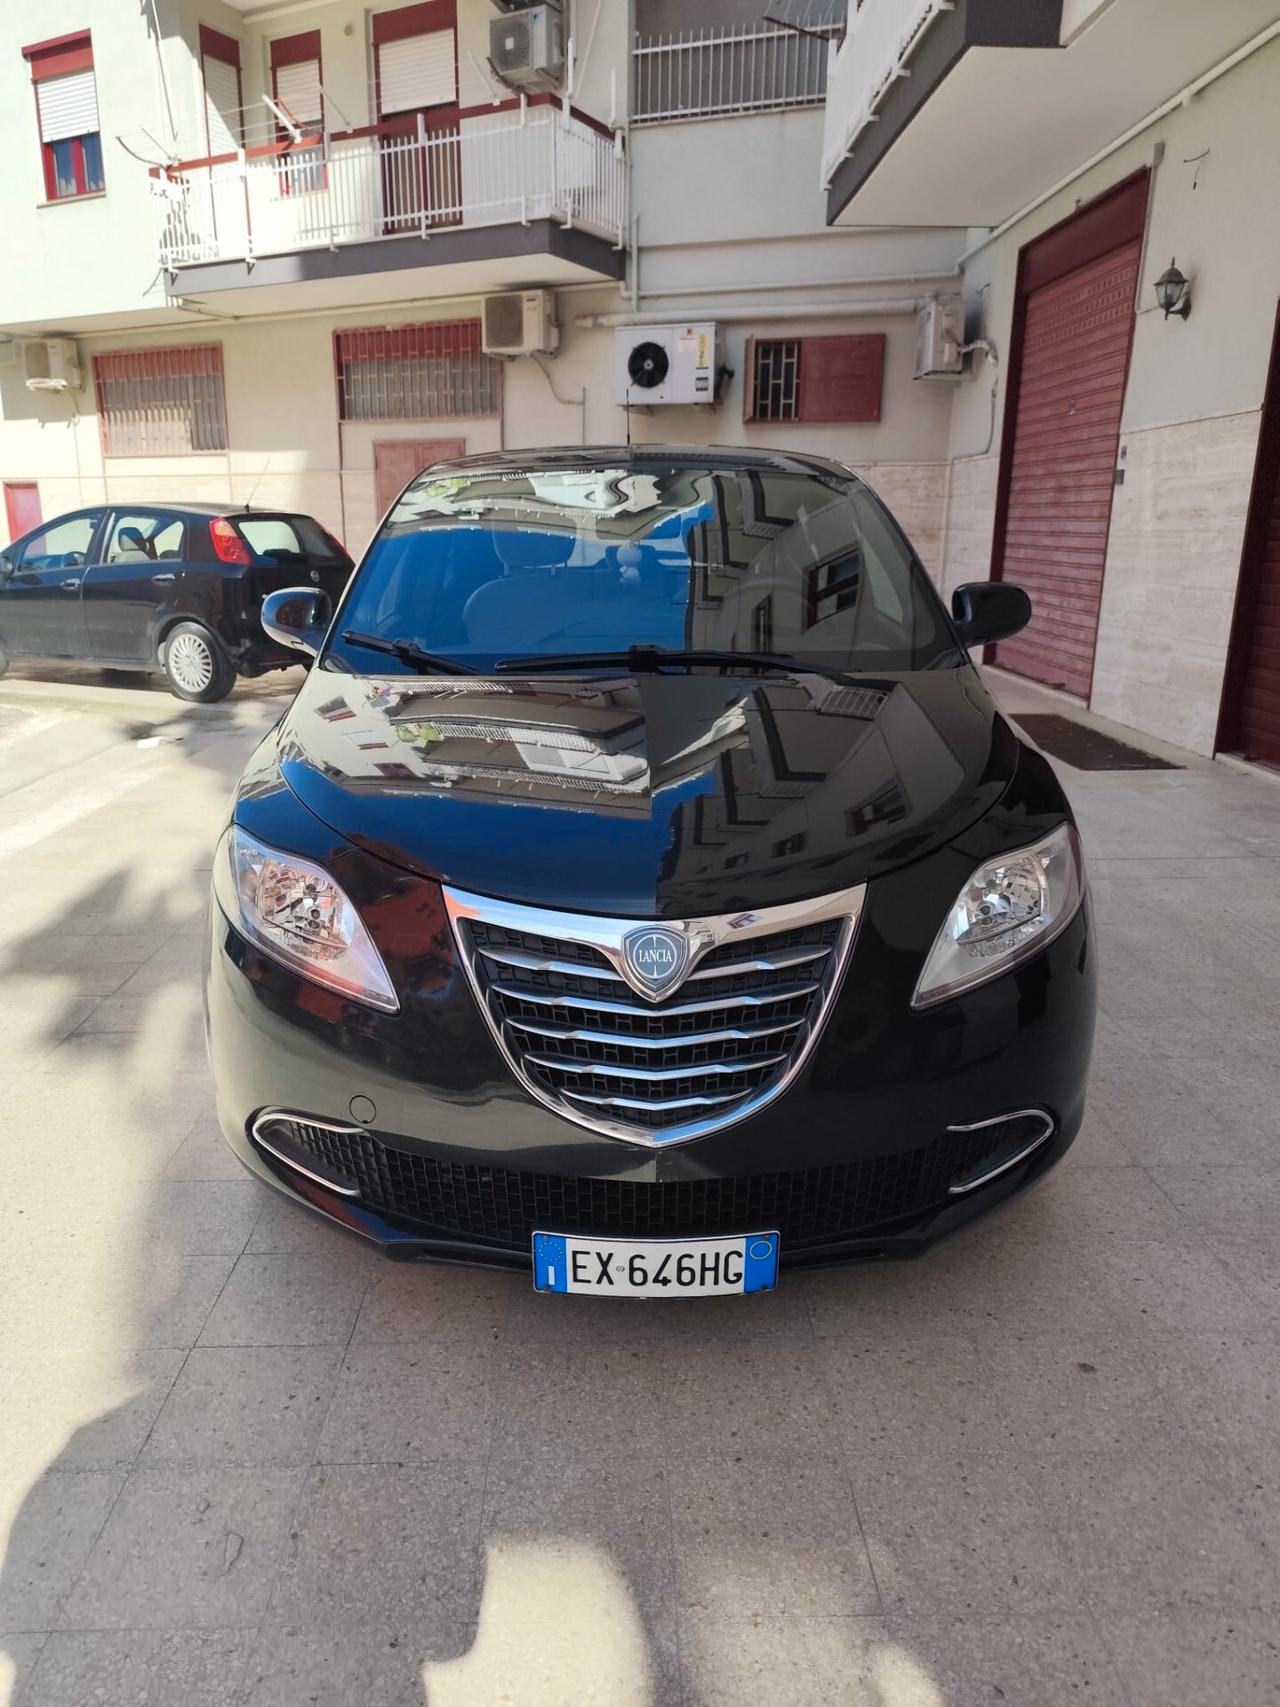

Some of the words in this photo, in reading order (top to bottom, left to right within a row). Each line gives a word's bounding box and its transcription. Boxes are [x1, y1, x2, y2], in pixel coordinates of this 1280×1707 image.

[639, 949, 673, 962] LANCIA
[572, 1250, 614, 1285] EX
[628, 1250, 743, 1287] 646HG
